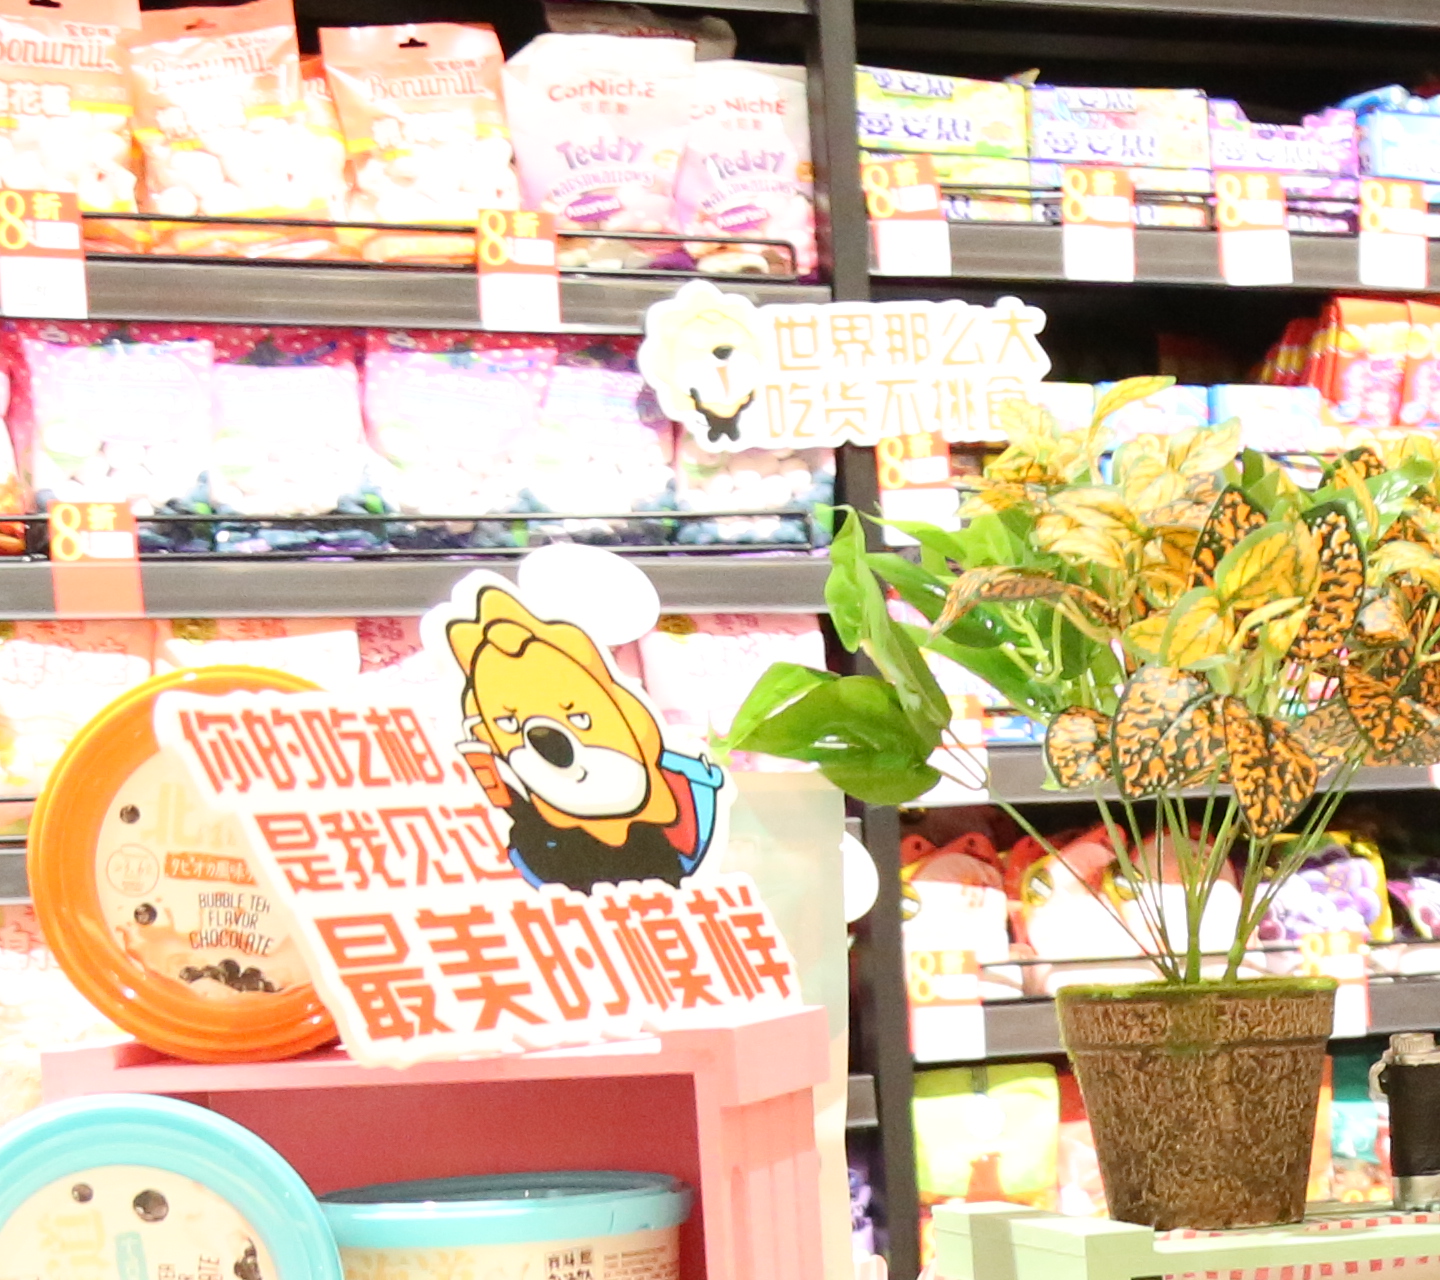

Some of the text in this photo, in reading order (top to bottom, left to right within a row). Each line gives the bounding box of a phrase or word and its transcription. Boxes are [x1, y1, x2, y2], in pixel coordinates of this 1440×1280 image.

[554, 135, 647, 172] Teddy
[772, 309, 1045, 372] 世界那么大
[256, 805, 520, 894] 是我见过
[314, 888, 796, 1042] 最美的模样
